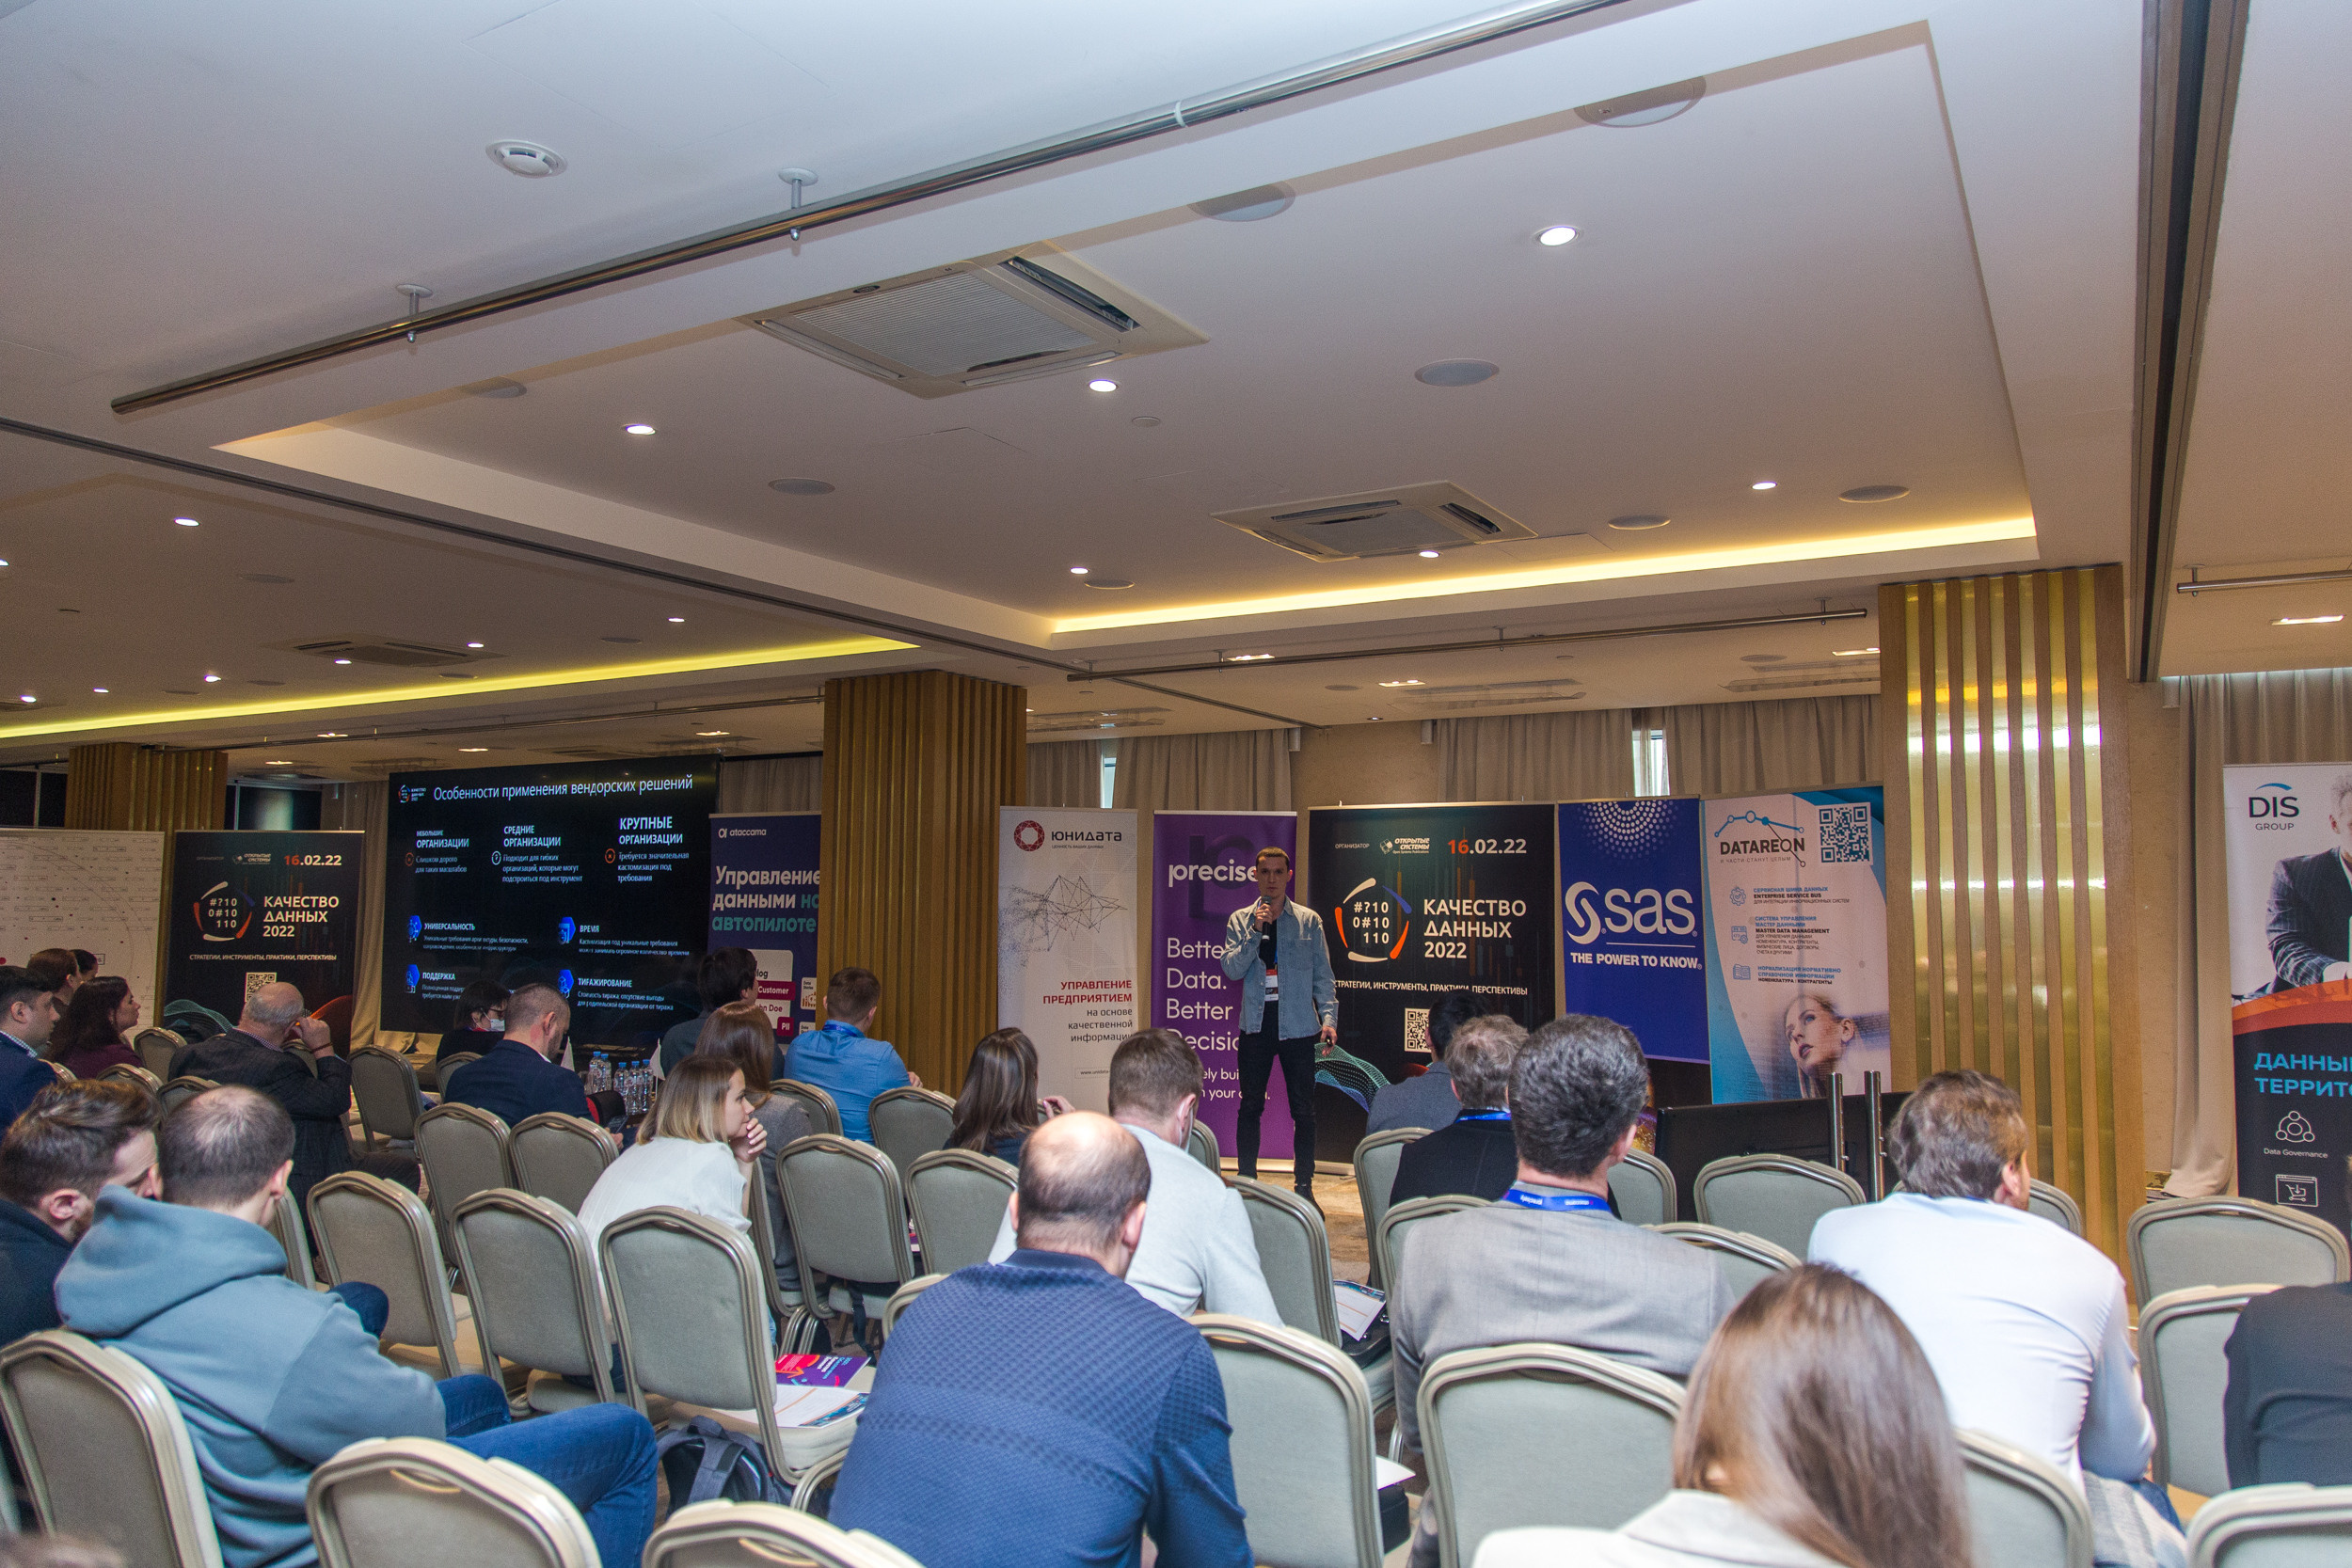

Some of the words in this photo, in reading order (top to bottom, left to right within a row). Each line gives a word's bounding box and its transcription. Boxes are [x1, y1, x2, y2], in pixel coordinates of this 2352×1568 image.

[434, 785, 500, 800] Особенности
[501, 784, 567, 800] применения
[570, 781, 636, 797] вендорских
[639, 774, 693, 795] решений
[2249, 797, 2299, 818] DIS
[619, 816, 673, 830] КРУПНЫЕ
[503, 825, 534, 835] СРЕДНИЕ
[416, 838, 469, 849] ОРГАНИЗАЦИИ
[503, 836, 562, 848] ОРГАНИЗАЦИИ
[618, 833, 683, 846] ОРГАНИЗАЦИИ
[1448, 838, 1527, 854] 16.02.22
[1720, 838, 1805, 855] DATAREON
[284, 855, 342, 866] 16.02.22
[503, 854, 529, 863] Подходит
[619, 852, 647, 862] Требуется
[617, 874, 653, 883] требования
[716, 865, 820, 890] Управление
[1168, 859, 1259, 887] precise
[263, 895, 340, 908] КАЧЕСТВО
[712, 894, 797, 911] данными
[1354, 901, 1389, 913] #?10
[1423, 899, 1527, 917] КАЧЕСТВО
[262, 911, 328, 923] ДАННЫХ
[1352, 917, 1390, 928] 0#10
[216, 920, 237, 928] 110
[424, 923, 476, 931] УНИВЕРСАЛЬНОСТЬ
[580, 925, 600, 933] ВРЕМЯ
[712, 916, 817, 933] автопилоте
[1423, 920, 1513, 938] ДАННЫХ
[262, 926, 295, 938] 2022
[1363, 932, 1390, 944] 110
[1167, 938, 1224, 959] Bette
[1424, 942, 1468, 959] 2022
[1570, 952, 1593, 963] THE
[1596, 953, 1640, 966] POWER
[1641, 955, 1658, 967] TO
[422, 972, 456, 981] ПОДДЕРЖКА
[756, 969, 769, 979] log
[1167, 968, 1227, 990] Data.
[757, 986, 789, 994] Customer
[1061, 980, 1132, 990] УПРАВЛЕНИЕ
[1373, 982, 1429, 992] ИНСТРУМЕНТЫ,
[1472, 985, 1528, 995] ПЕРСПЕКТИВЫ
[1043, 993, 1132, 1006] ПРЕДПРИЯТИЕМ
[769, 1004, 783, 1012] Doe
[1167, 998, 1233, 1021] Better
[1068, 1020, 1133, 1030] качественной
[2253, 1053, 2352, 1072] ДАННЫ
[1221, 1069, 1240, 1080] bui
[2254, 1077, 2352, 1098] ТЕРРИТ
[1209, 1089, 1236, 1101] your
[2264, 1148, 2281, 1156] Data
[2282, 1148, 2328, 1159] Governance
